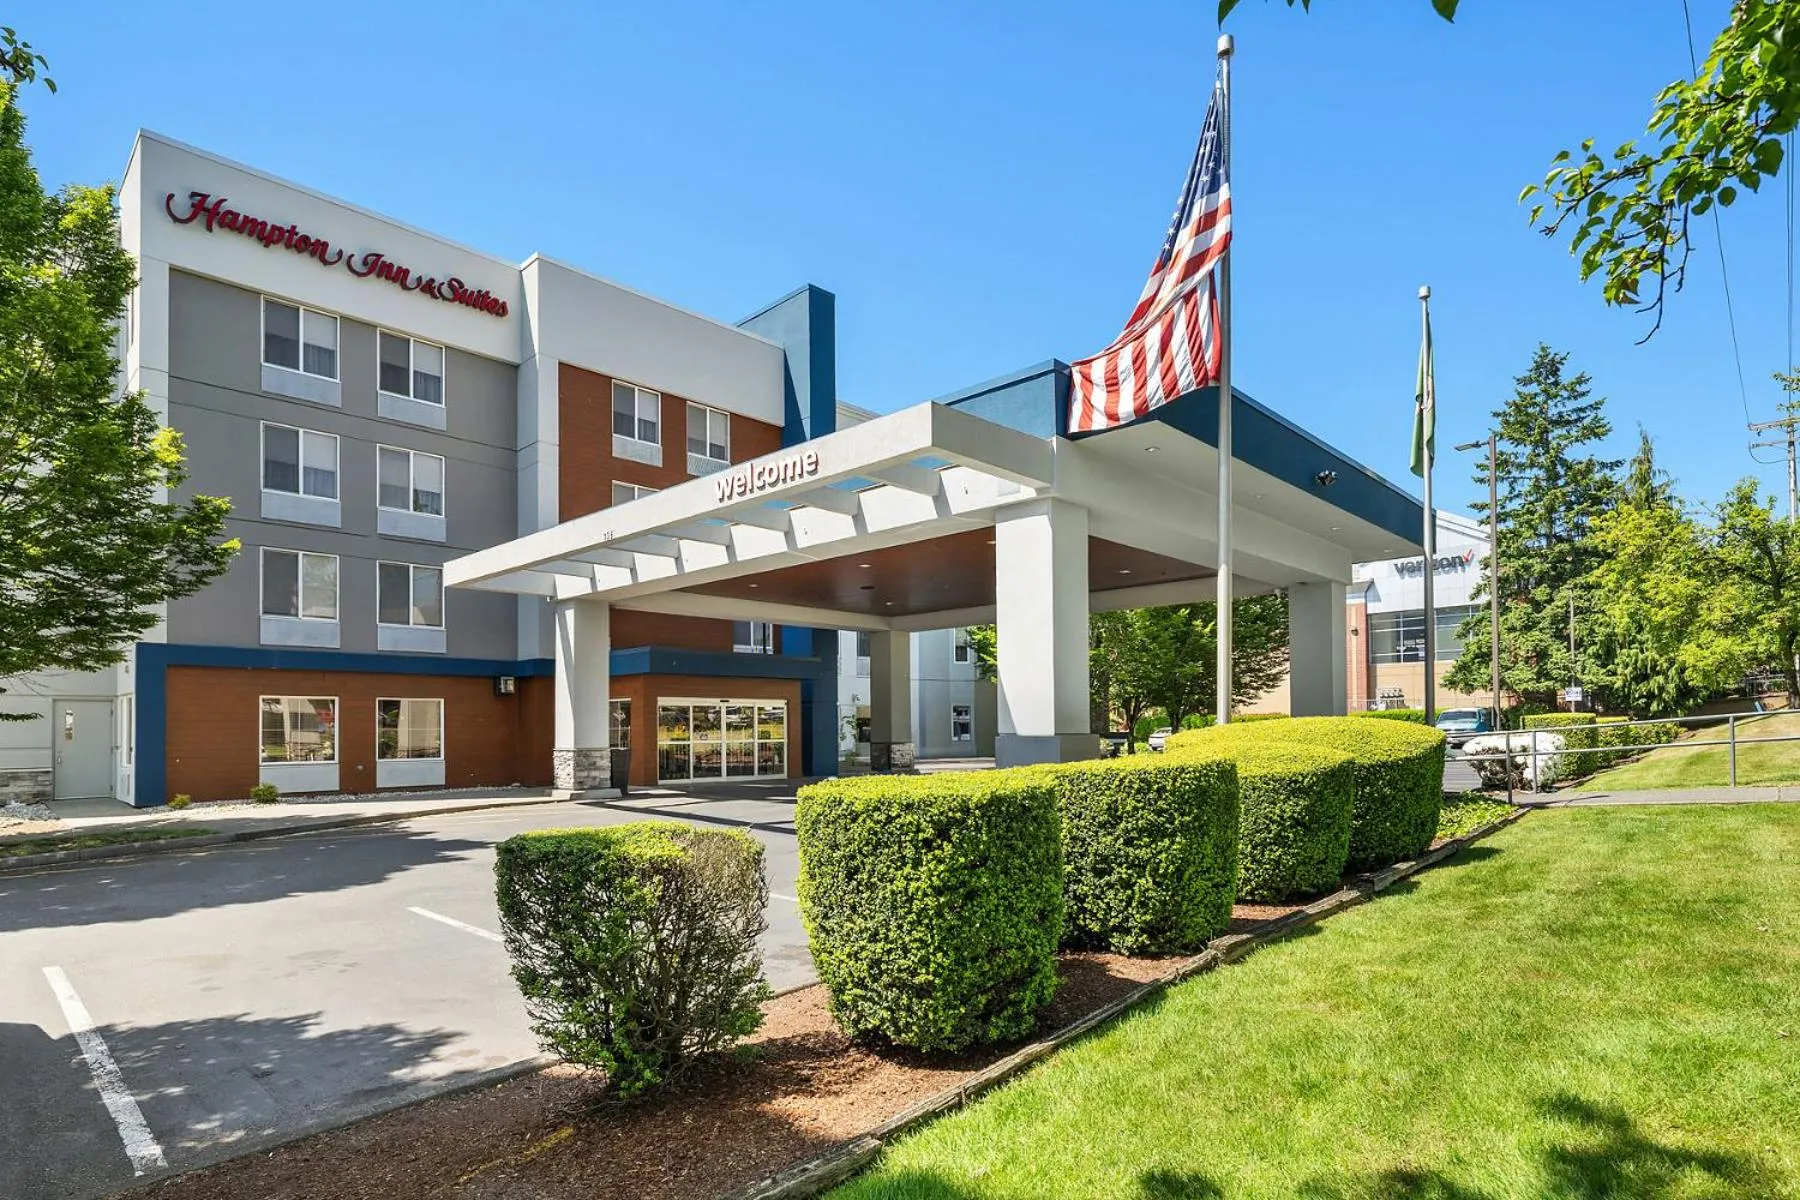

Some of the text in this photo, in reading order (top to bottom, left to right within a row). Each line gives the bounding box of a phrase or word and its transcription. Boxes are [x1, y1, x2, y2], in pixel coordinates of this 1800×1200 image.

[165, 191, 509, 318] Hampton Inn & Suites
[715, 450, 819, 503] welcome
[1394, 555, 1465, 576] verzon
